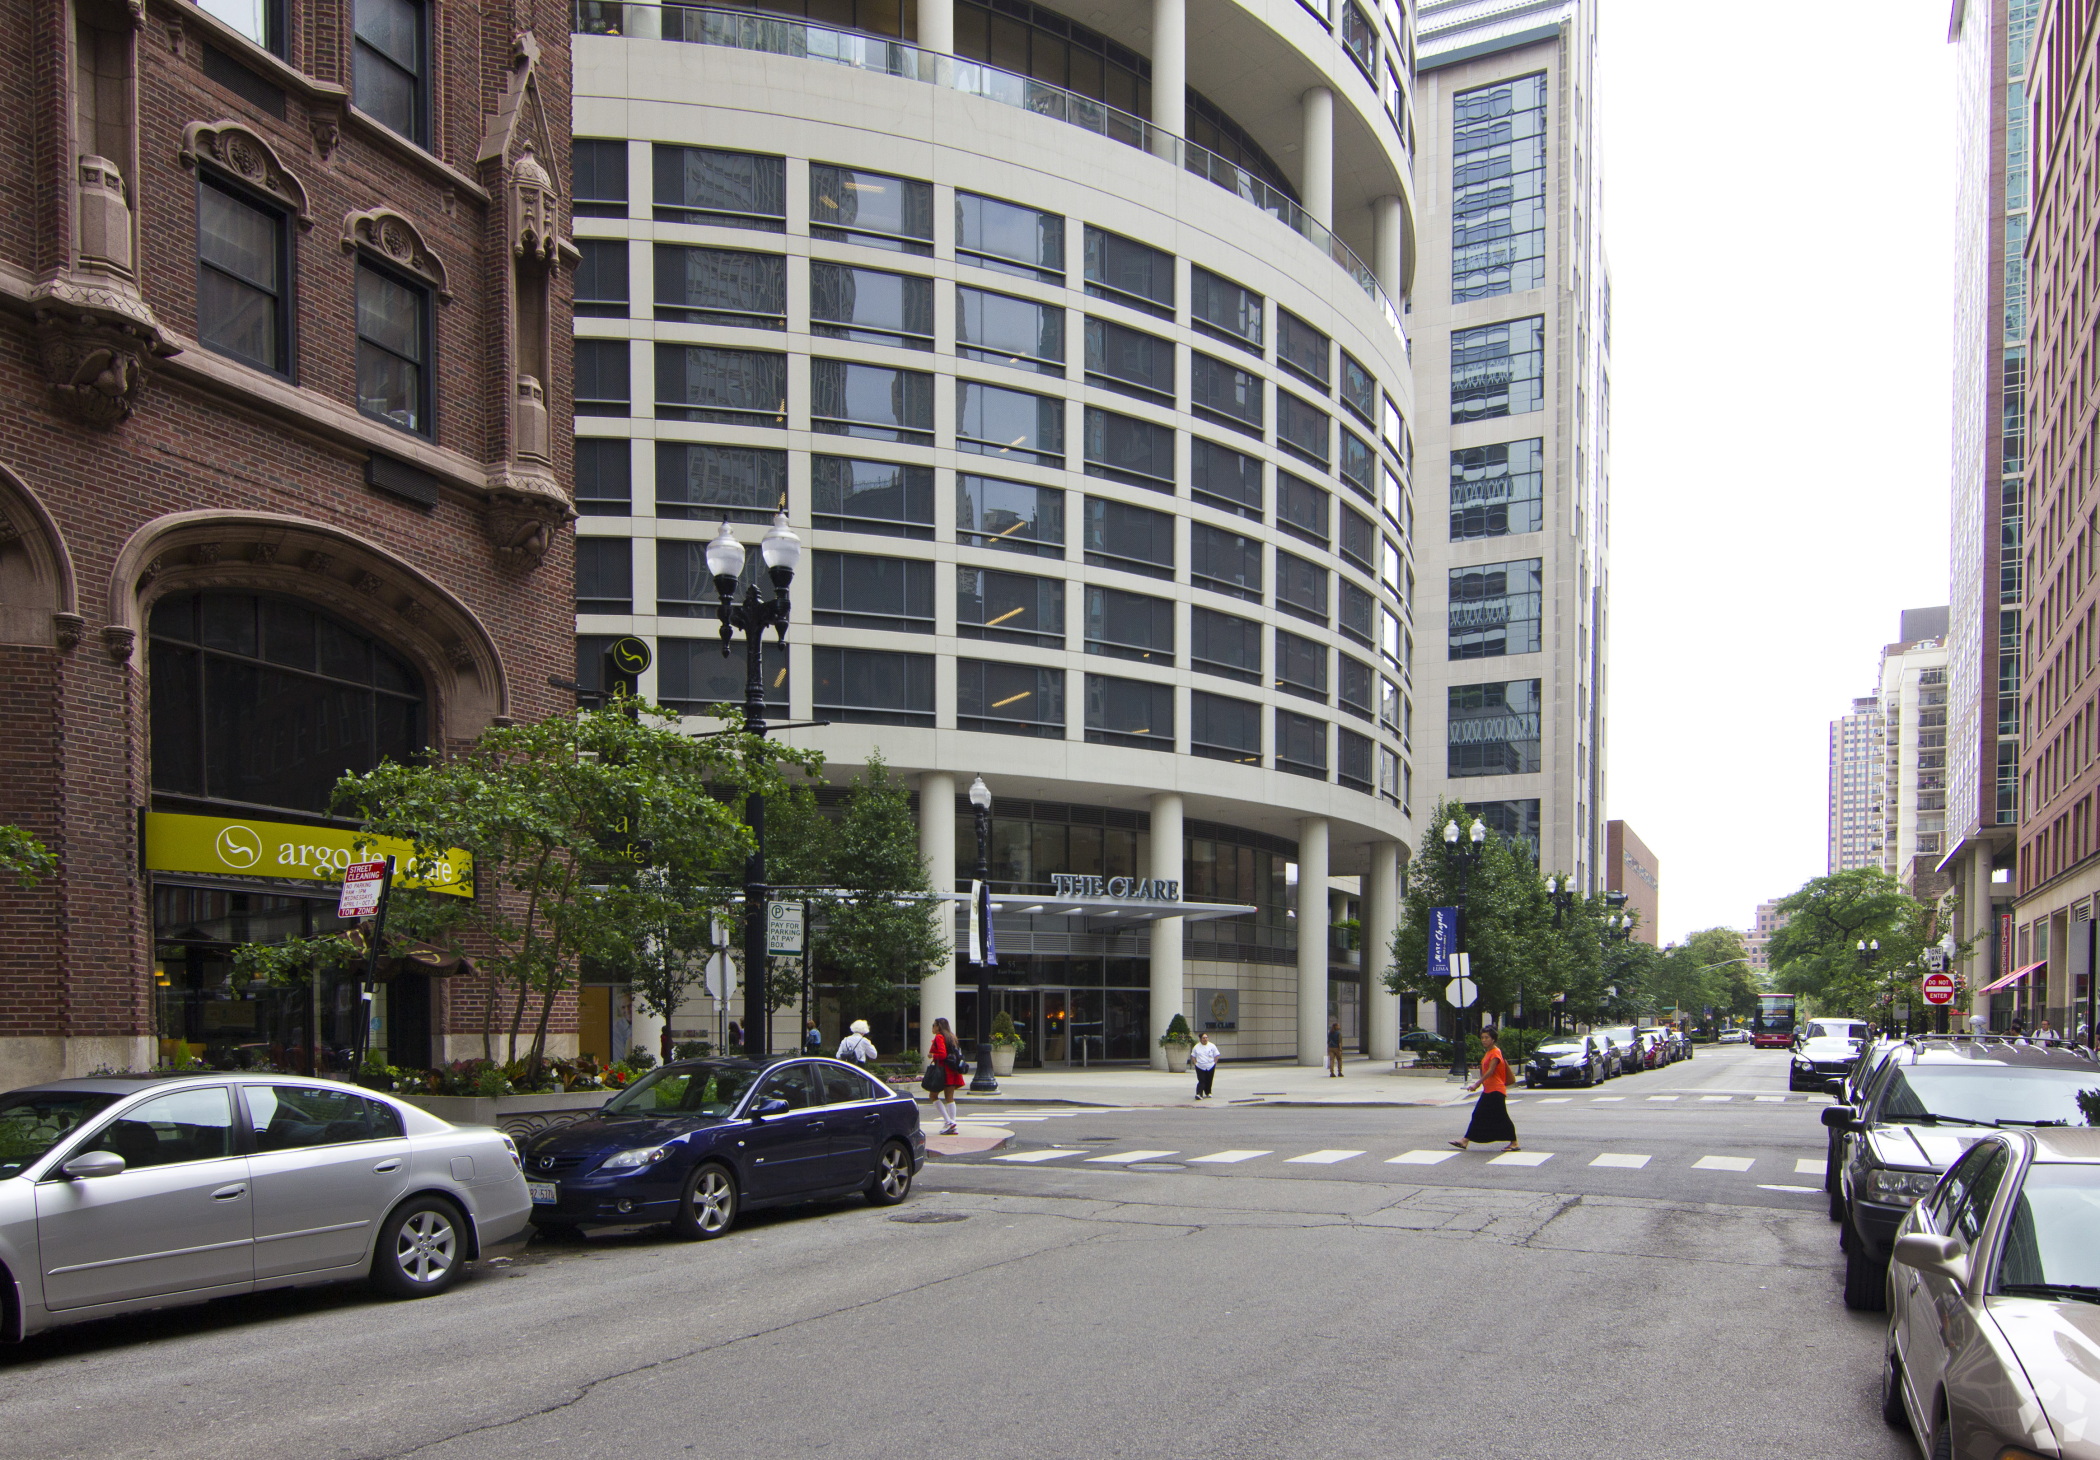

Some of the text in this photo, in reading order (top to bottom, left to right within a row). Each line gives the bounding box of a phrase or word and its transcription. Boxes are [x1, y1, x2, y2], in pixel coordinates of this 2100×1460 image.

[277, 842, 352, 877] argo
[350, 865, 373, 873] STREET
[348, 871, 380, 881] CLEANING
[1051, 873, 1180, 900] THE CLARE
[357, 907, 375, 915] ZONE
[785, 922, 800, 930] FOR
[770, 929, 801, 937] PARKING
[781, 935, 795, 943] PAY
[770, 941, 784, 949] BOX
[1205, 1021, 1236, 1029] THE CLARE
